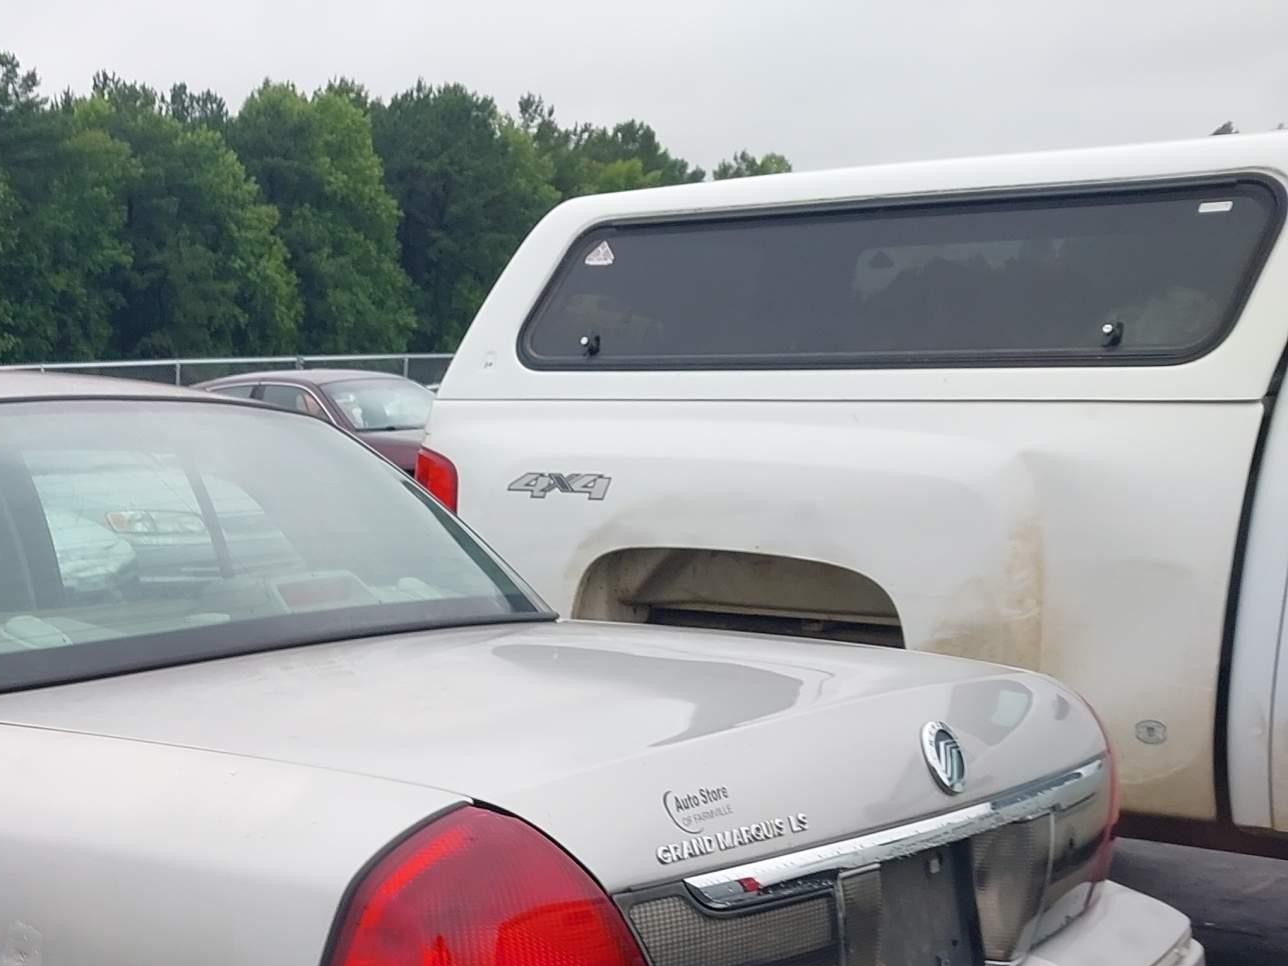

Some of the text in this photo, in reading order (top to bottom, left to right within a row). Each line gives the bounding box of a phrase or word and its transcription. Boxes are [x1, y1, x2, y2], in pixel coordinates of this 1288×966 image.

[674, 786, 729, 813] Auto Store
[656, 812, 809, 865] GRAND MARQUIS LS
